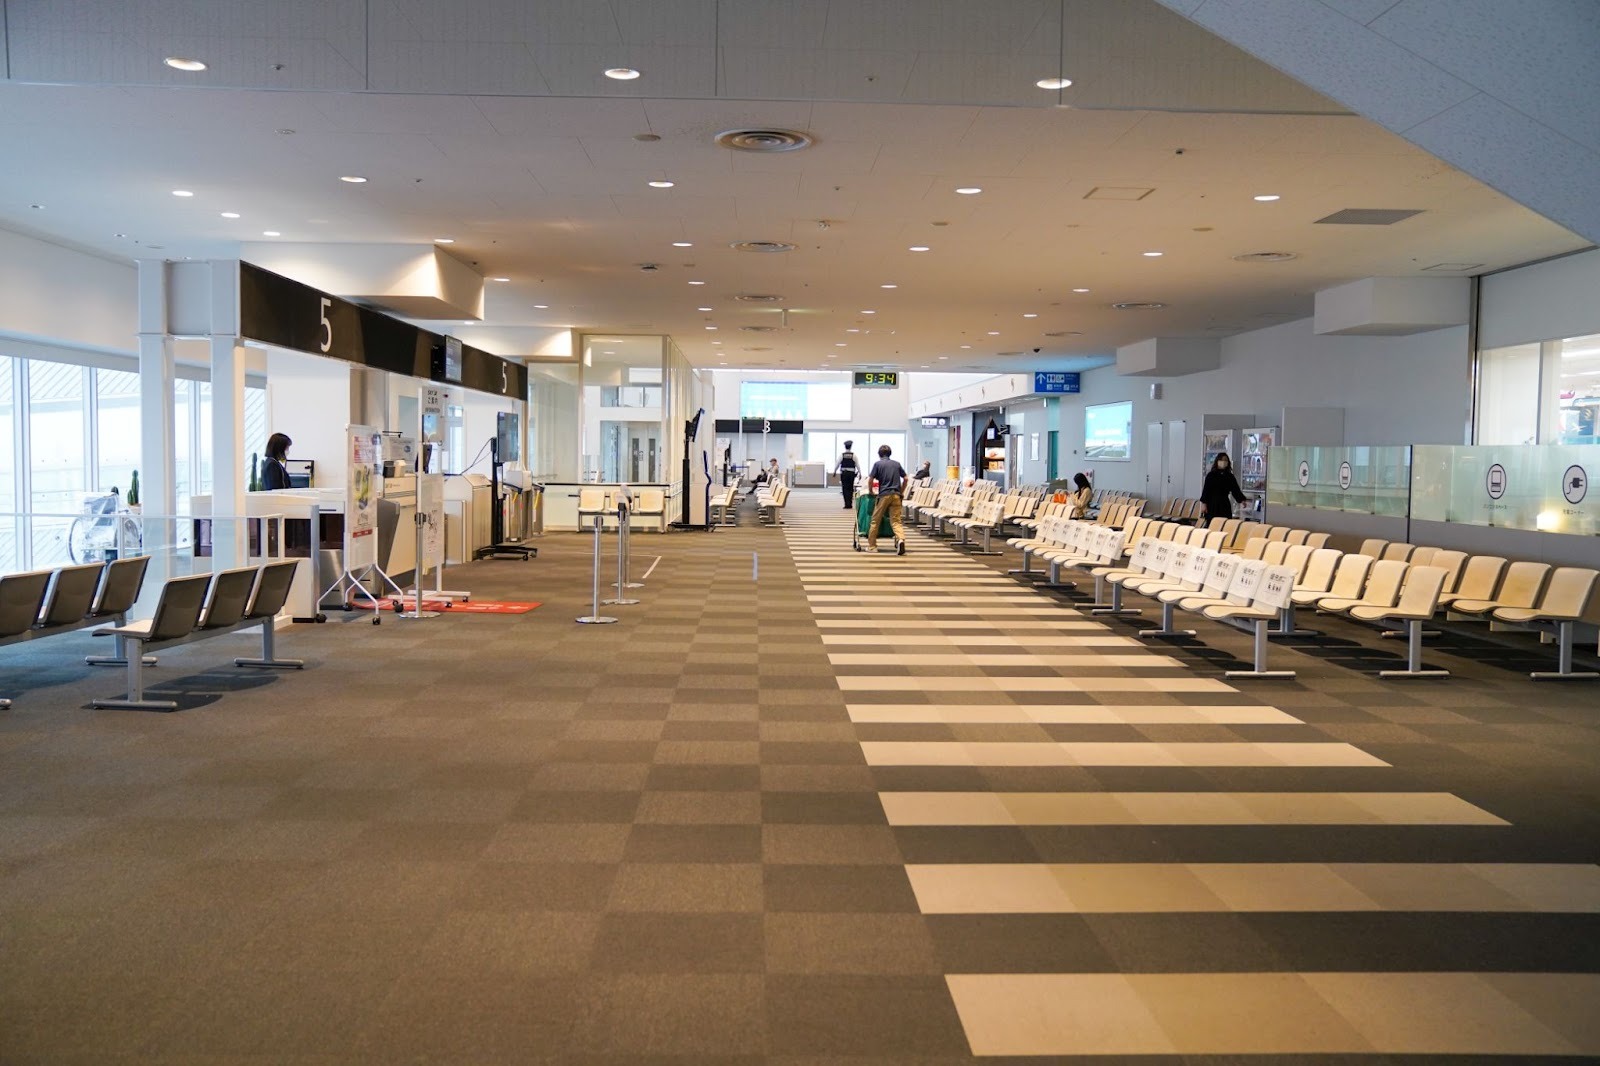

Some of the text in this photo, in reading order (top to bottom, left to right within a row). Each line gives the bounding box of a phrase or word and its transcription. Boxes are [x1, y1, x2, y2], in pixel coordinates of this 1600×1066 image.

[320, 297, 332, 353] 5
[502, 361, 508, 394] 5
[865, 373, 895, 384] 9:34
[762, 420, 771, 433] 3
